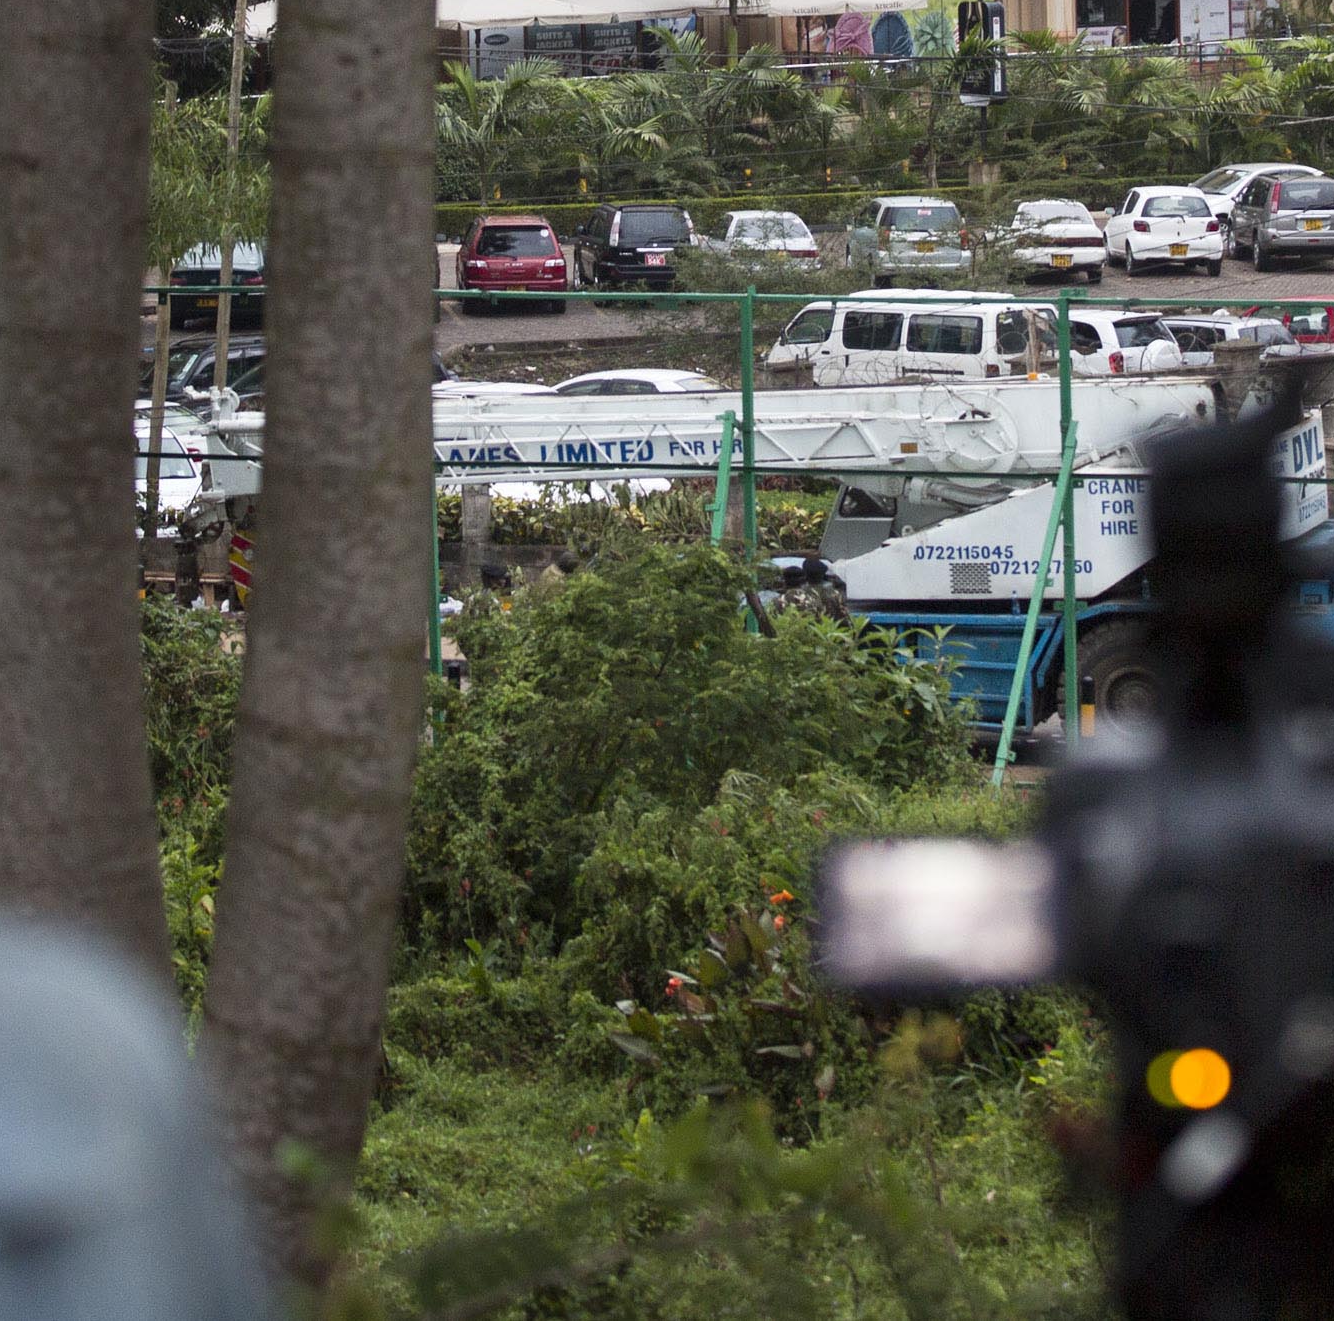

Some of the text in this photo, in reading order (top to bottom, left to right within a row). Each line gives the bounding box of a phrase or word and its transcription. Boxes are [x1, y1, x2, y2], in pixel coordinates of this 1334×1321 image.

[536, 32, 563, 41] SUITS
[593, 28, 622, 37] SUITS
[535, 41, 574, 49] JACKETS
[593, 37, 632, 47] JACKETS
[540, 439, 654, 464] LIMITED
[670, 441, 705, 457] FOR
[1292, 425, 1323, 473] DVL
[1088, 479, 1146, 494] CRANE
[1101, 500, 1134, 515] FOR
[1101, 521, 1139, 535] HIRE
[916, 545, 1014, 560] 0722115045
[990, 559, 1093, 575] 07212750
